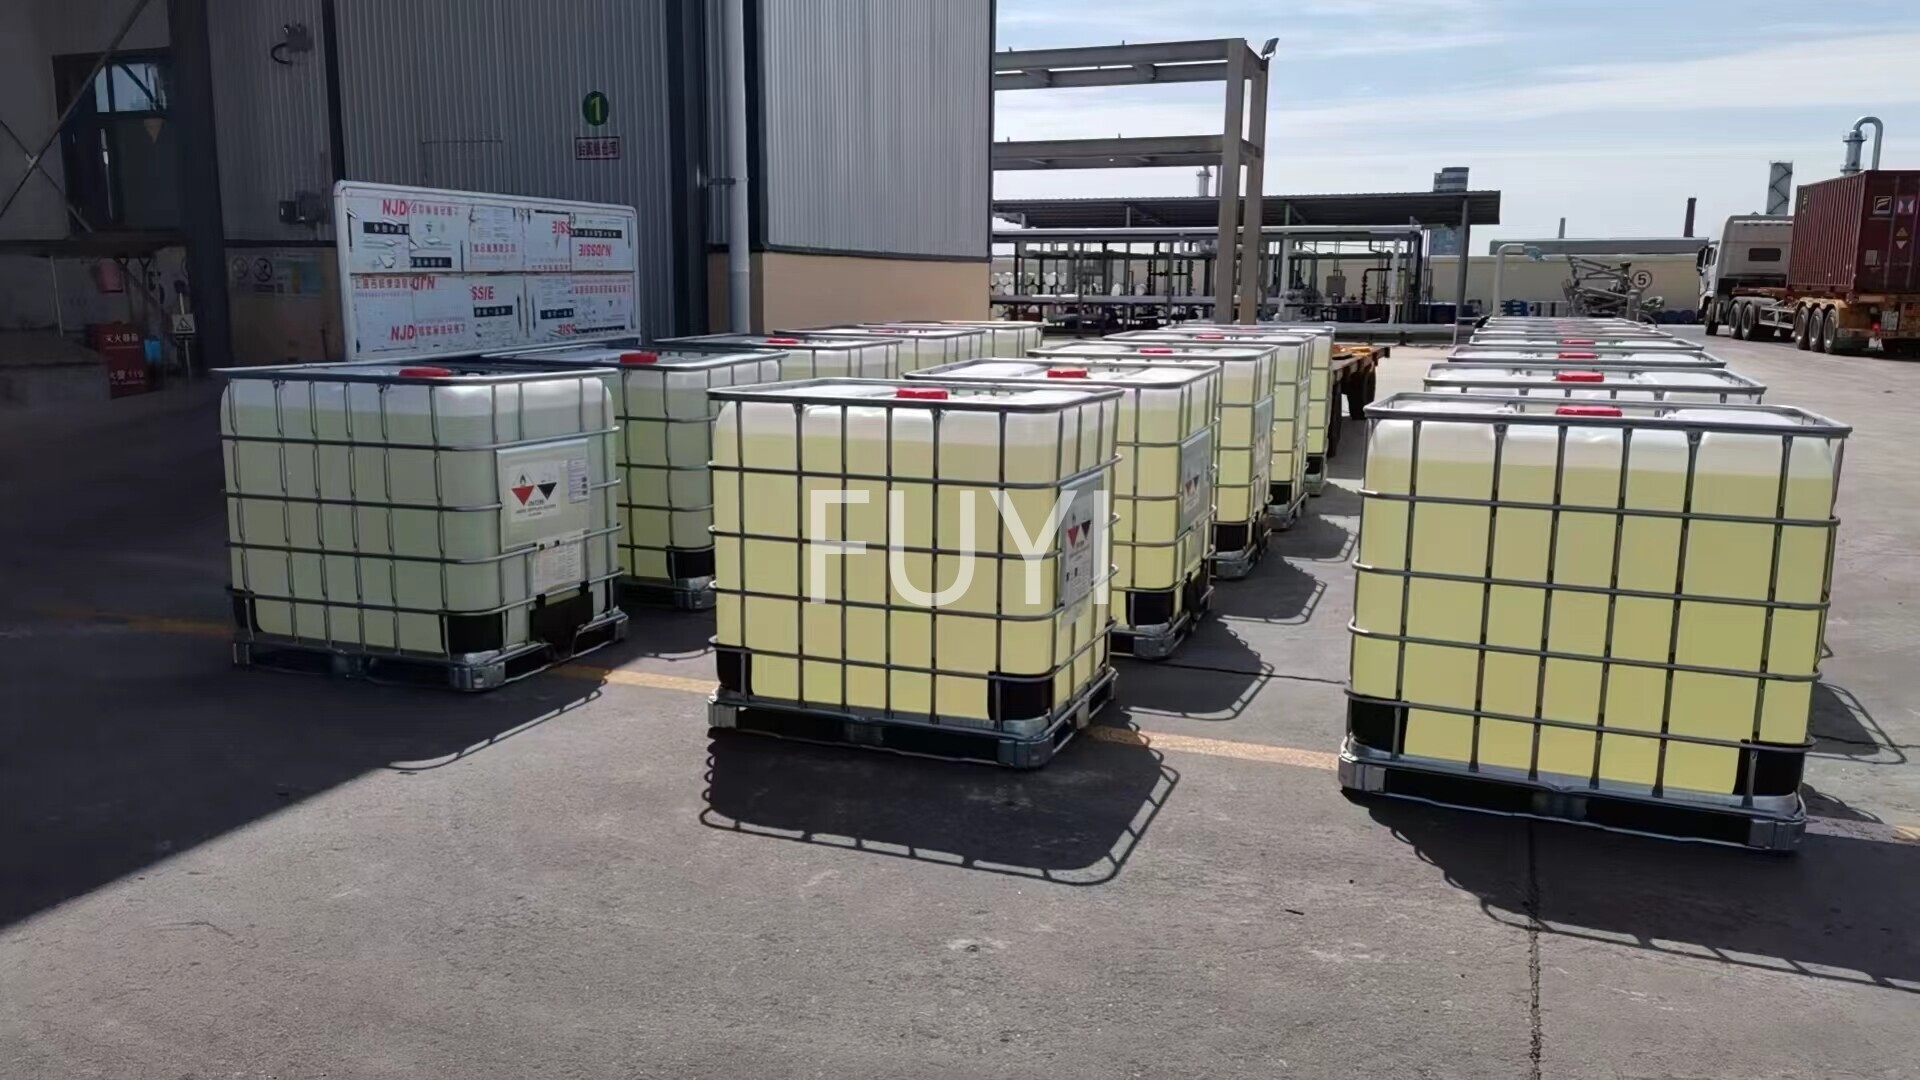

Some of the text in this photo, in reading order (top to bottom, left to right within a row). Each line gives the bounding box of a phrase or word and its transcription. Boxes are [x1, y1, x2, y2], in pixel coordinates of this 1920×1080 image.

[591, 96, 601, 121] 1
[382, 199, 407, 216] NJD
[578, 243, 612, 257] NJDSSIE
[1637, 274, 1647, 286] 5
[471, 286, 494, 301] SSIE
[391, 325, 415, 342] NJD
